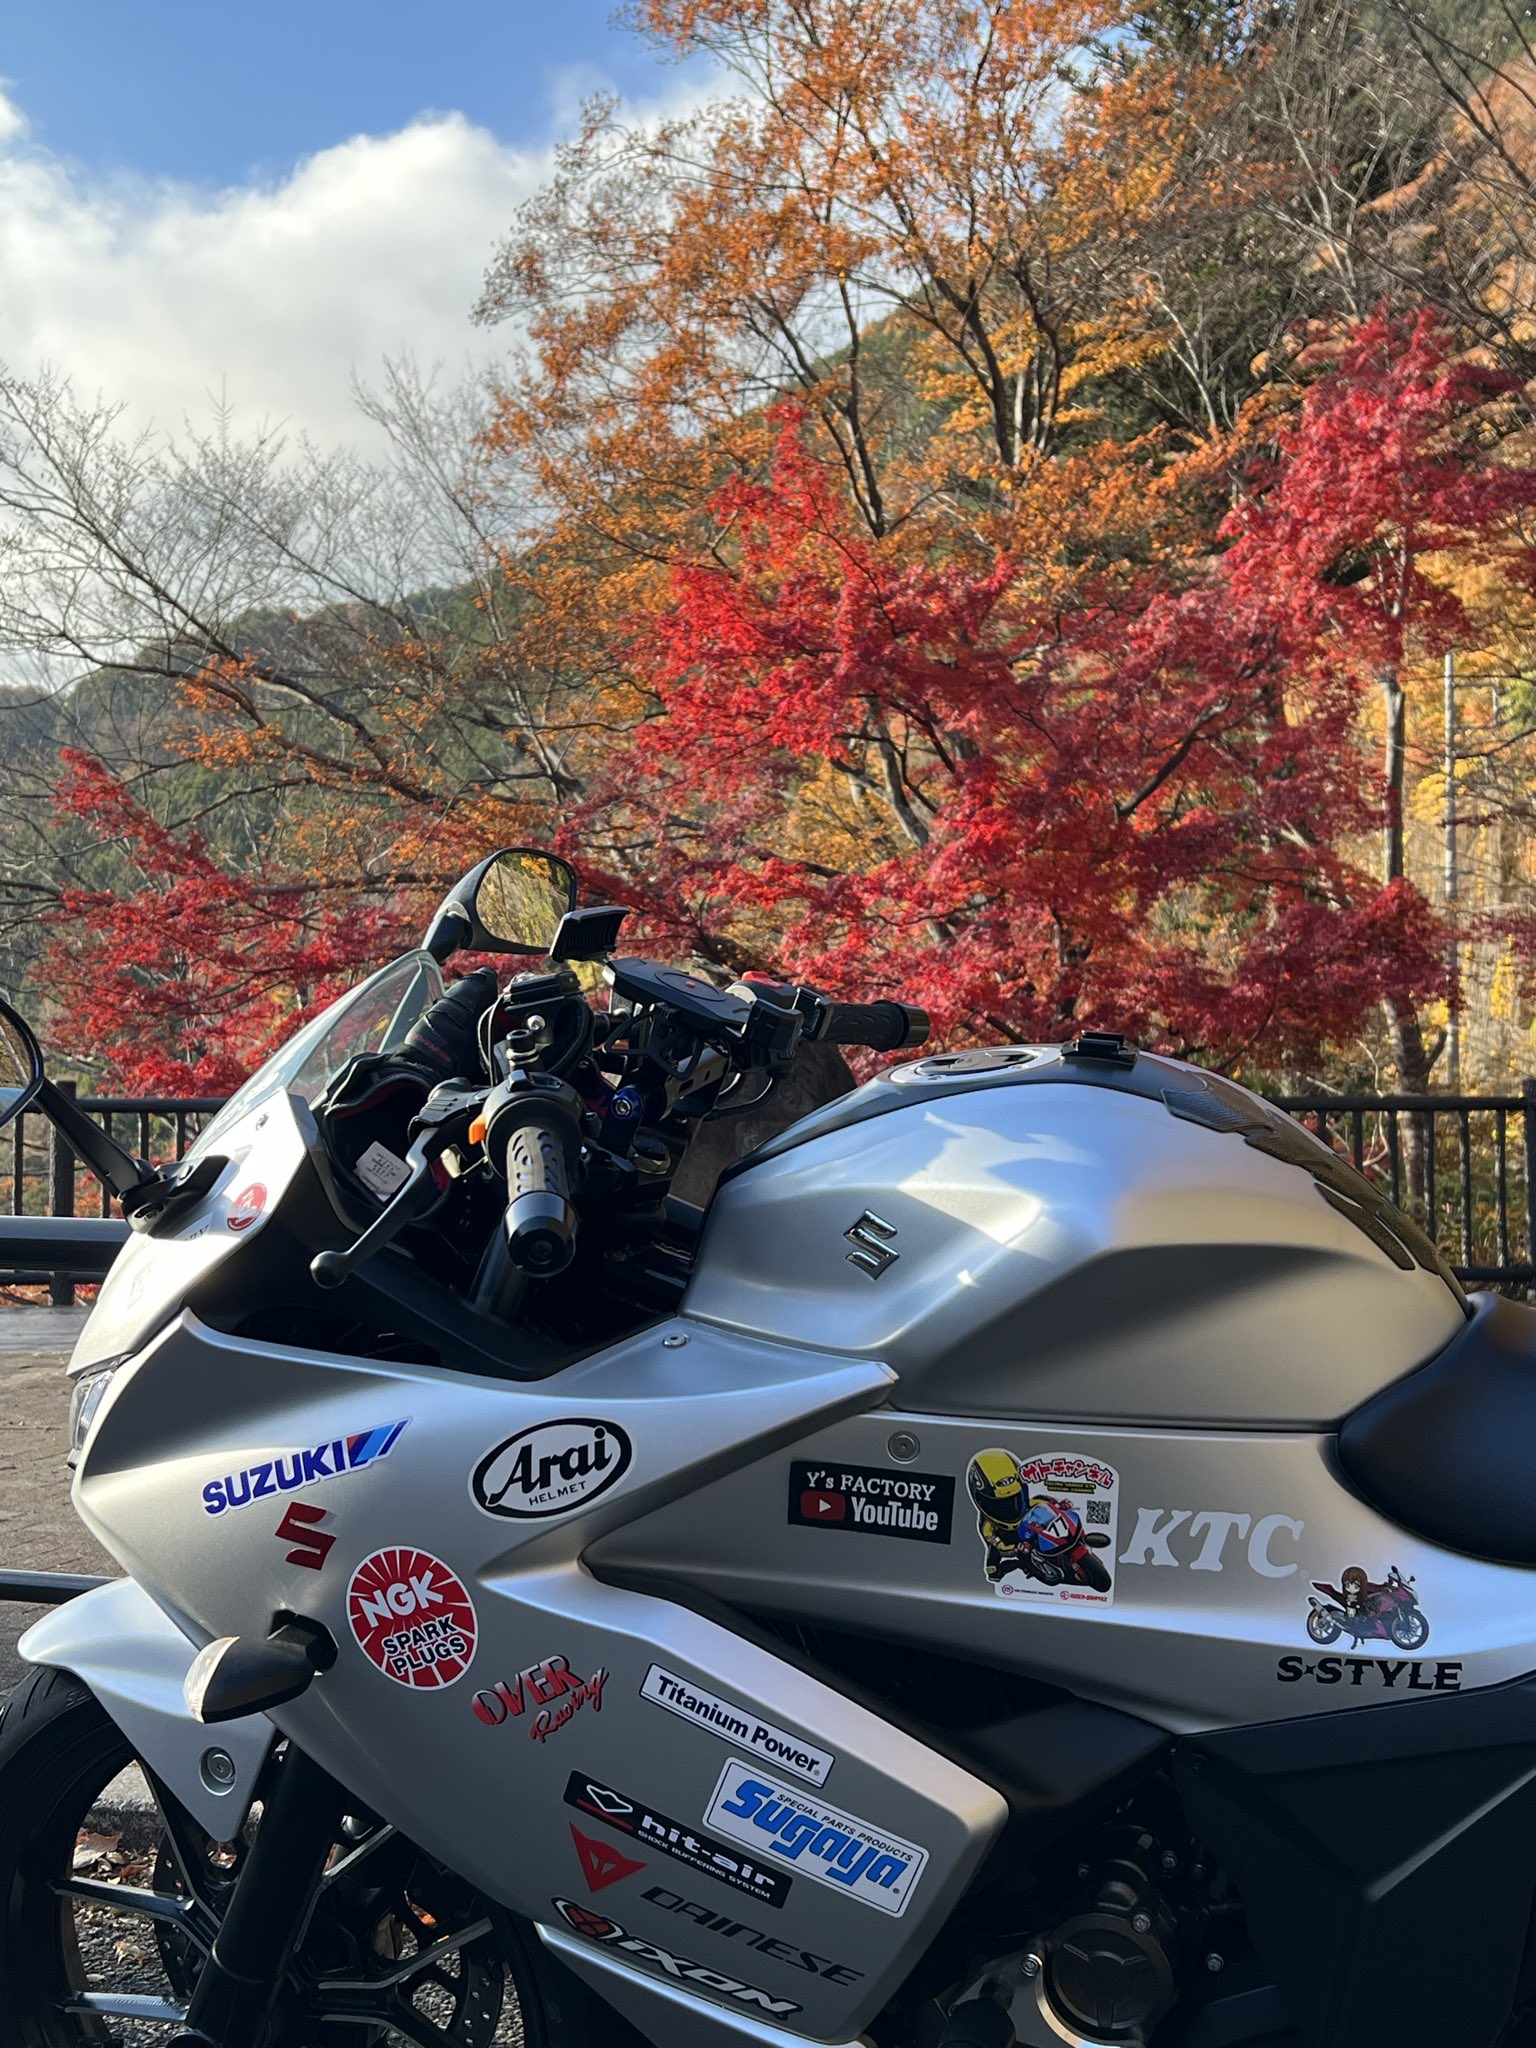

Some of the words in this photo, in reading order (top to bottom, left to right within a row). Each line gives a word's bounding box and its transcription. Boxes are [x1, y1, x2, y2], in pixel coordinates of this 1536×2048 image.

[203, 1440, 346, 1514] SUZUKI
[485, 1427, 614, 1505] Arai
[528, 1480, 588, 1507] HELMET
[806, 1470, 836, 1491] Y's
[841, 1475, 937, 1503] FACTORY
[851, 1495, 939, 1533] YouTube
[1047, 1516, 1068, 1538] 77
[1118, 1507, 1304, 1578] KTC
[358, 1570, 444, 1629] NGK
[382, 1614, 458, 1656] SPARK
[391, 1637, 468, 1677] PLUGS
[471, 1654, 585, 1725] OVER
[529, 1667, 610, 1743] Racing
[657, 1674, 749, 1739] Titanium
[641, 1815, 775, 1886] hit-air
[720, 1779, 909, 1888] Sugaya
[776, 1794, 818, 1820] SPECIAL
[821, 1815, 856, 1836] PARTS
[857, 1832, 914, 1862] PRODUCTS
[637, 1830, 669, 1850] SHOCK
[671, 1847, 727, 1879] BUFFERING
[728, 1874, 771, 1899] SYSTEM
[640, 1886, 866, 1987] DAINESE
